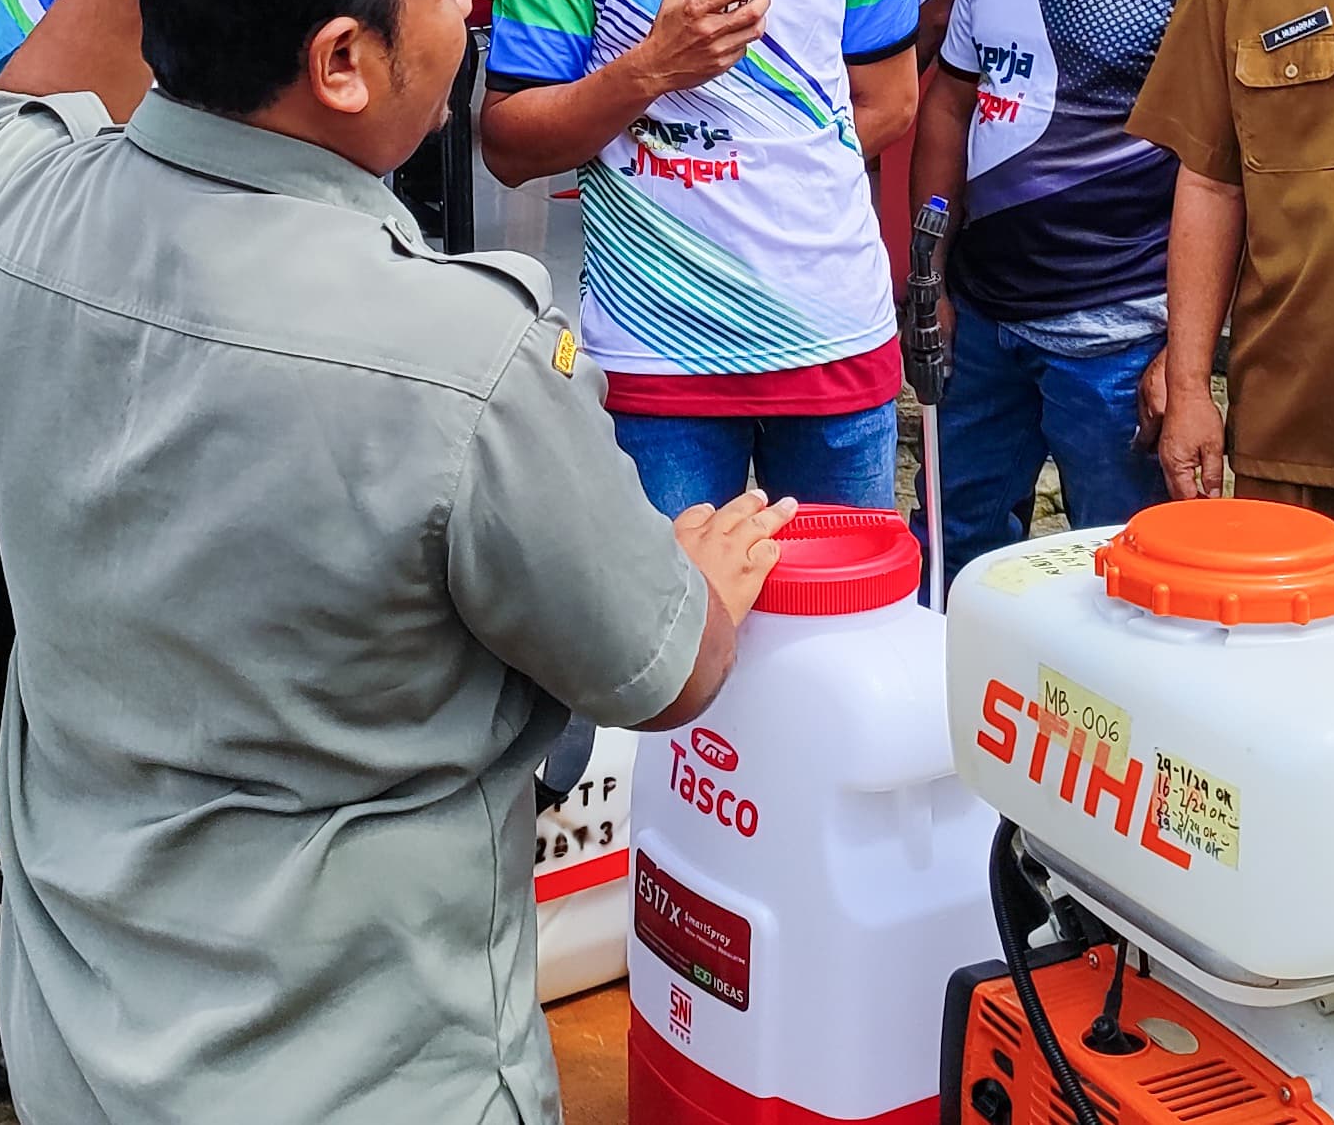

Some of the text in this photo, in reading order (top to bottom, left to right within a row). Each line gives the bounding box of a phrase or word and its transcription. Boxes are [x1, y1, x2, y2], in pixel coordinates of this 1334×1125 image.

[670, 738, 759, 838] Tasco
[977, 679, 1192, 871] STIHL
[670, 989, 692, 1028] SNI
[713, 976, 745, 1003] IDEAS
